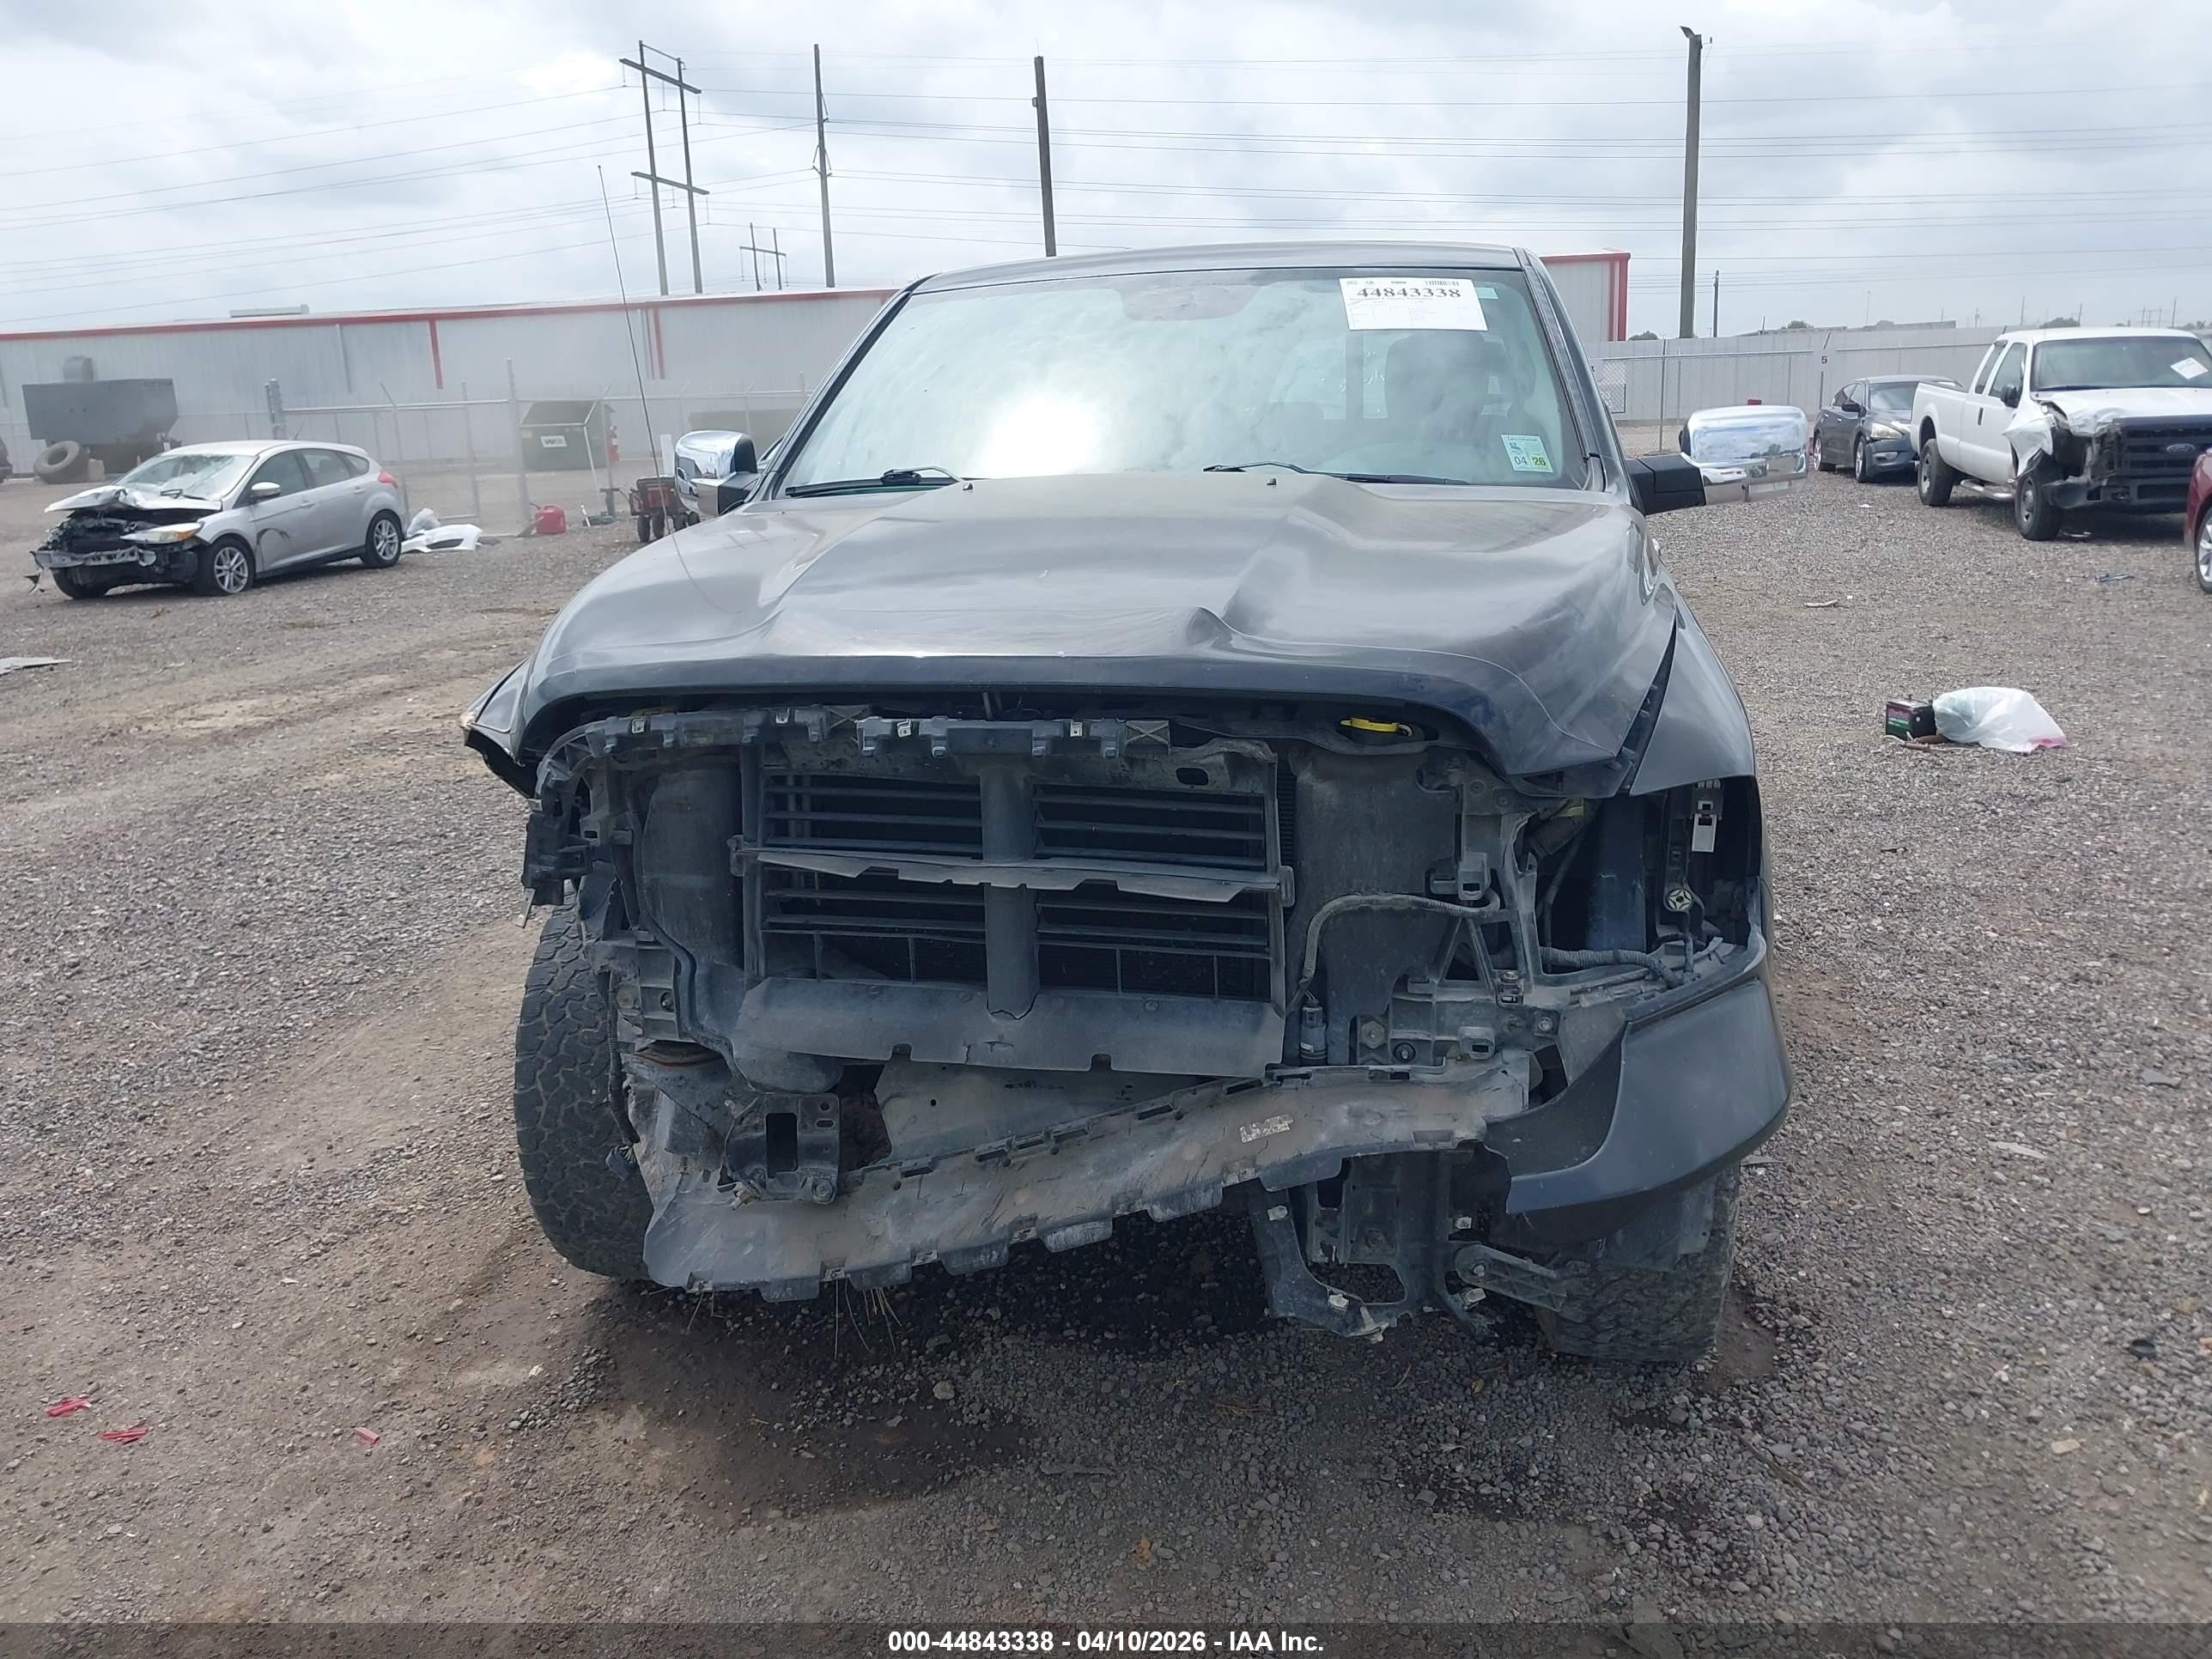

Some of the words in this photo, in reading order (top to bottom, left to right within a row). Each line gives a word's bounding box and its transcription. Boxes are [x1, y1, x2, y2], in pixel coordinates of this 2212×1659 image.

[1357, 287, 1462, 299] 44843338
[1820, 355, 1828, 364] 5
[1514, 456, 1528, 465] 04
[1532, 457, 1547, 466] 26
